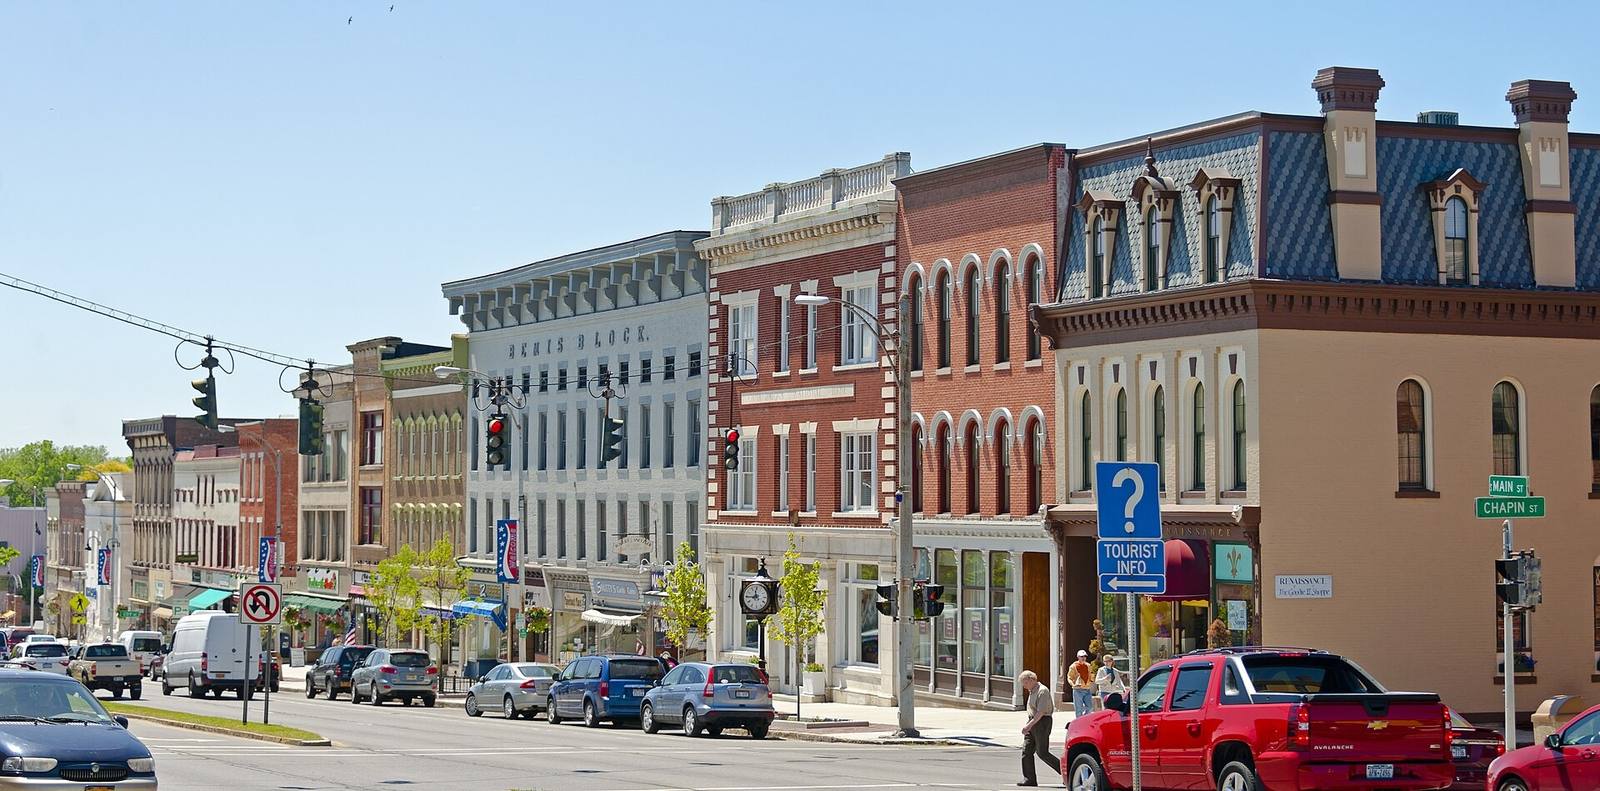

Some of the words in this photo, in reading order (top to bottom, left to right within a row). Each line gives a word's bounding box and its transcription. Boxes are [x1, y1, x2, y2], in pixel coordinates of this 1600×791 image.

[508, 337, 564, 360] BEMIS
[1492, 480, 1514, 493] MAIN
[1516, 484, 1524, 493] ST
[1483, 501, 1525, 515] CHAPIN
[1529, 504, 1538, 513] ST
[1104, 543, 1159, 559] TOURIST
[1117, 560, 1147, 575] INFO
[1279, 577, 1328, 585] RENAISSANCE
